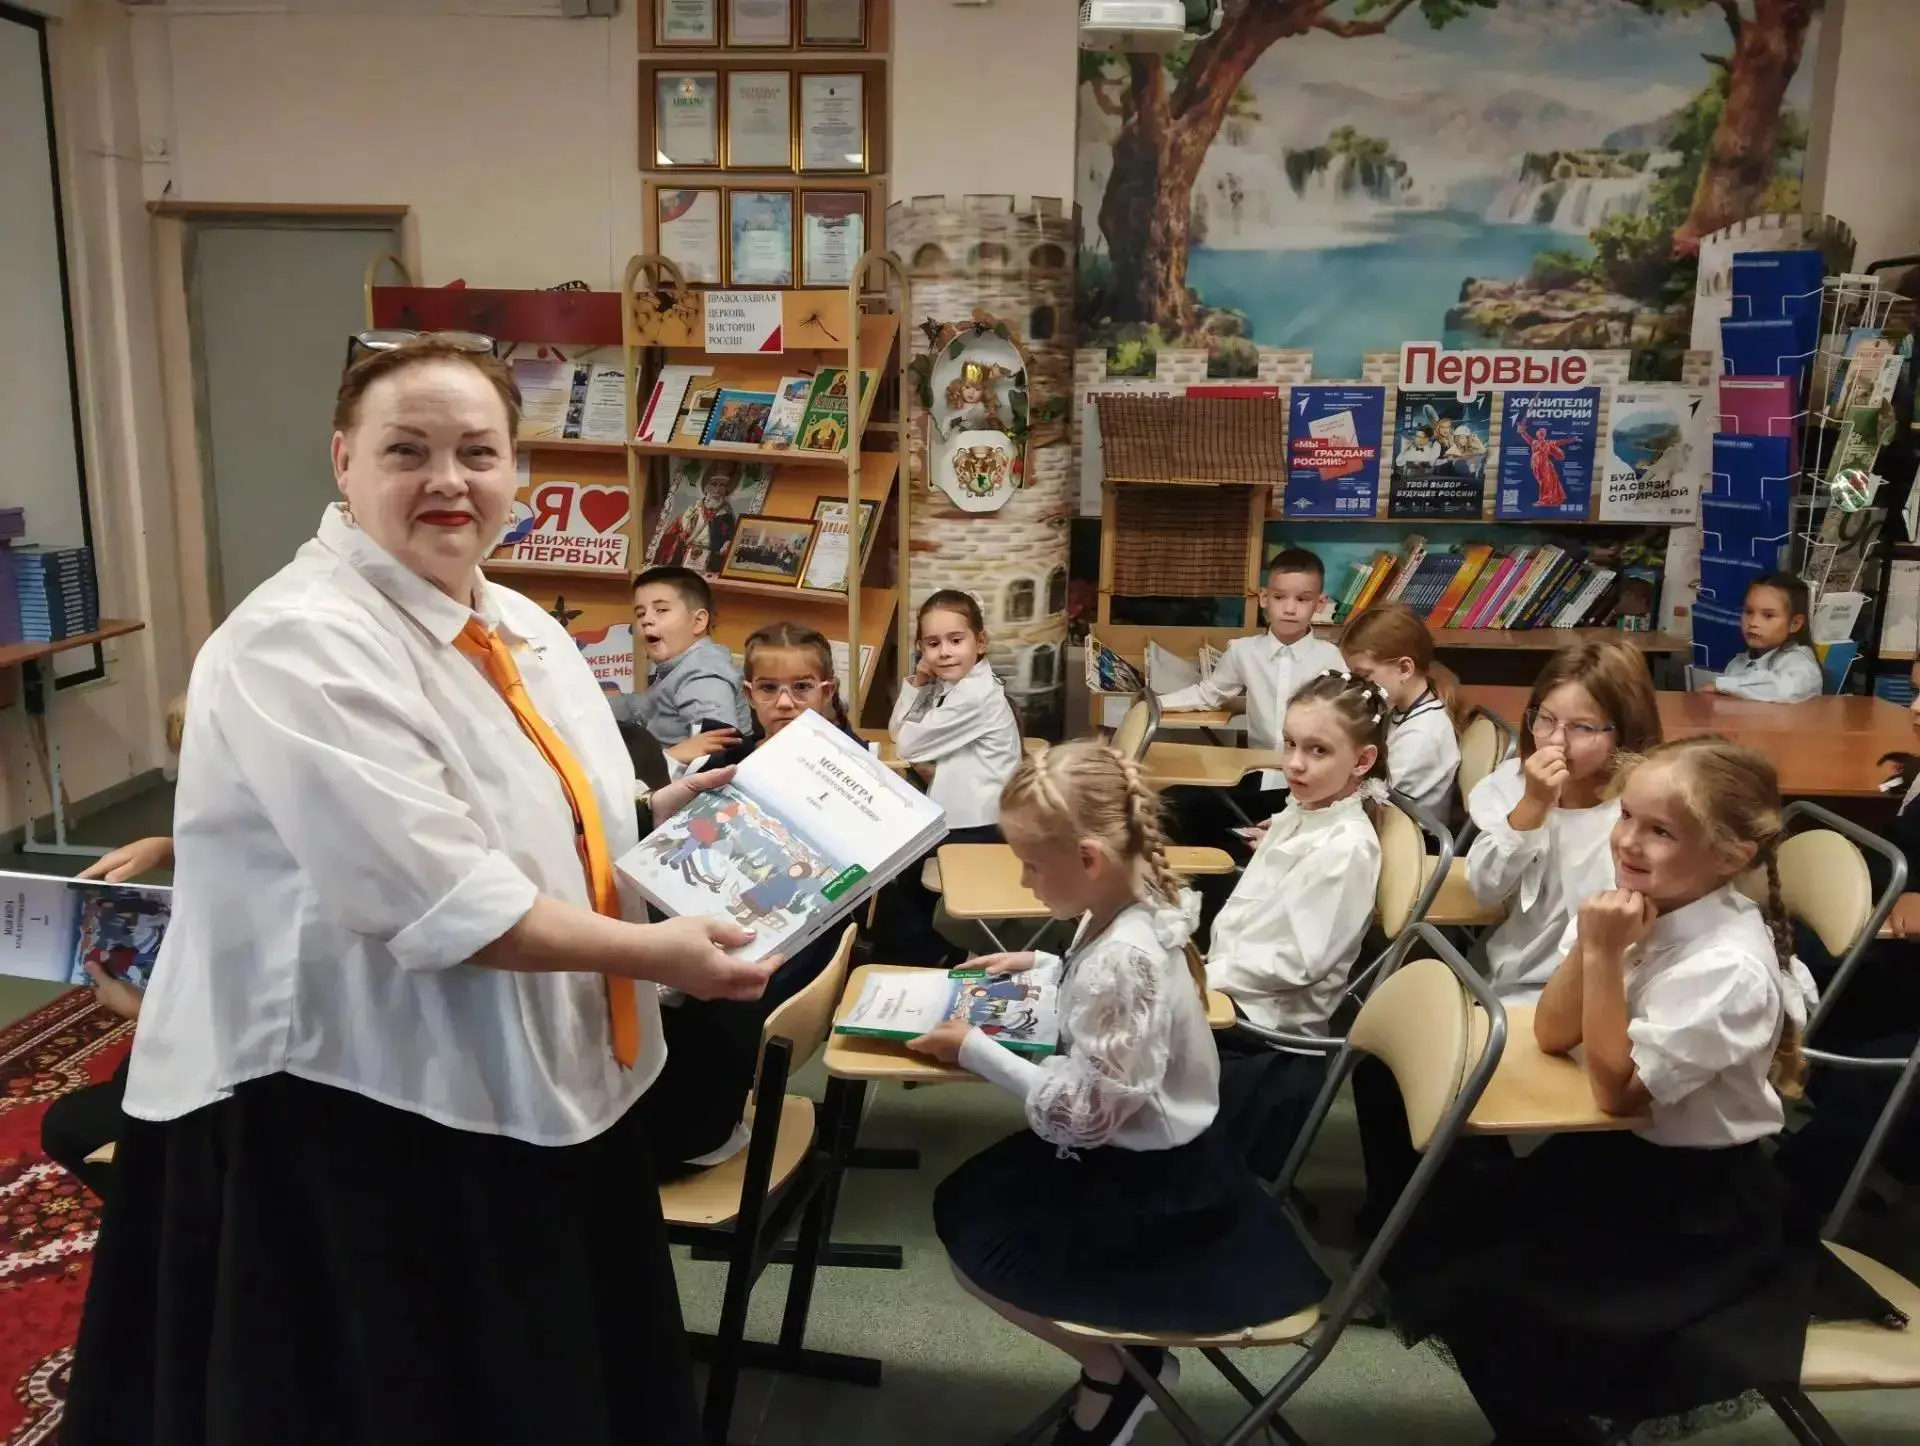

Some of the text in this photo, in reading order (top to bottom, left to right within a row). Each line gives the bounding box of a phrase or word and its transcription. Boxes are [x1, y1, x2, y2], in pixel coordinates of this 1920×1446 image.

[708, 294, 777, 303] ПРАВОСЛАВНАЯ
[708, 308, 746, 318] ЦЕРКОВЬ
[708, 323, 755, 332] В ИСТОРИИ
[708, 336, 743, 345] РОССИИ
[1405, 347, 1587, 396] Первые
[1510, 397, 1593, 408] ХРАНИТЕЛИ
[1526, 408, 1592, 418] ИСТОРИИ
[1314, 449, 1375, 458] ГРАЖДАНЕ
[1406, 480, 1429, 488] ТВОЙ
[1609, 479, 1671, 492] НА СВЯЗИ
[1396, 490, 1437, 498] БУДУЩЕЕ
[1608, 486, 1689, 502] С ПРИРОДОЙ
[533, 486, 575, 531] Я
[520, 533, 622, 549] ДВИЖЕНИЕ
[517, 546, 621, 566] ПЕРВЫХ
[586, 653, 633, 665] ЖЕНИЕ
